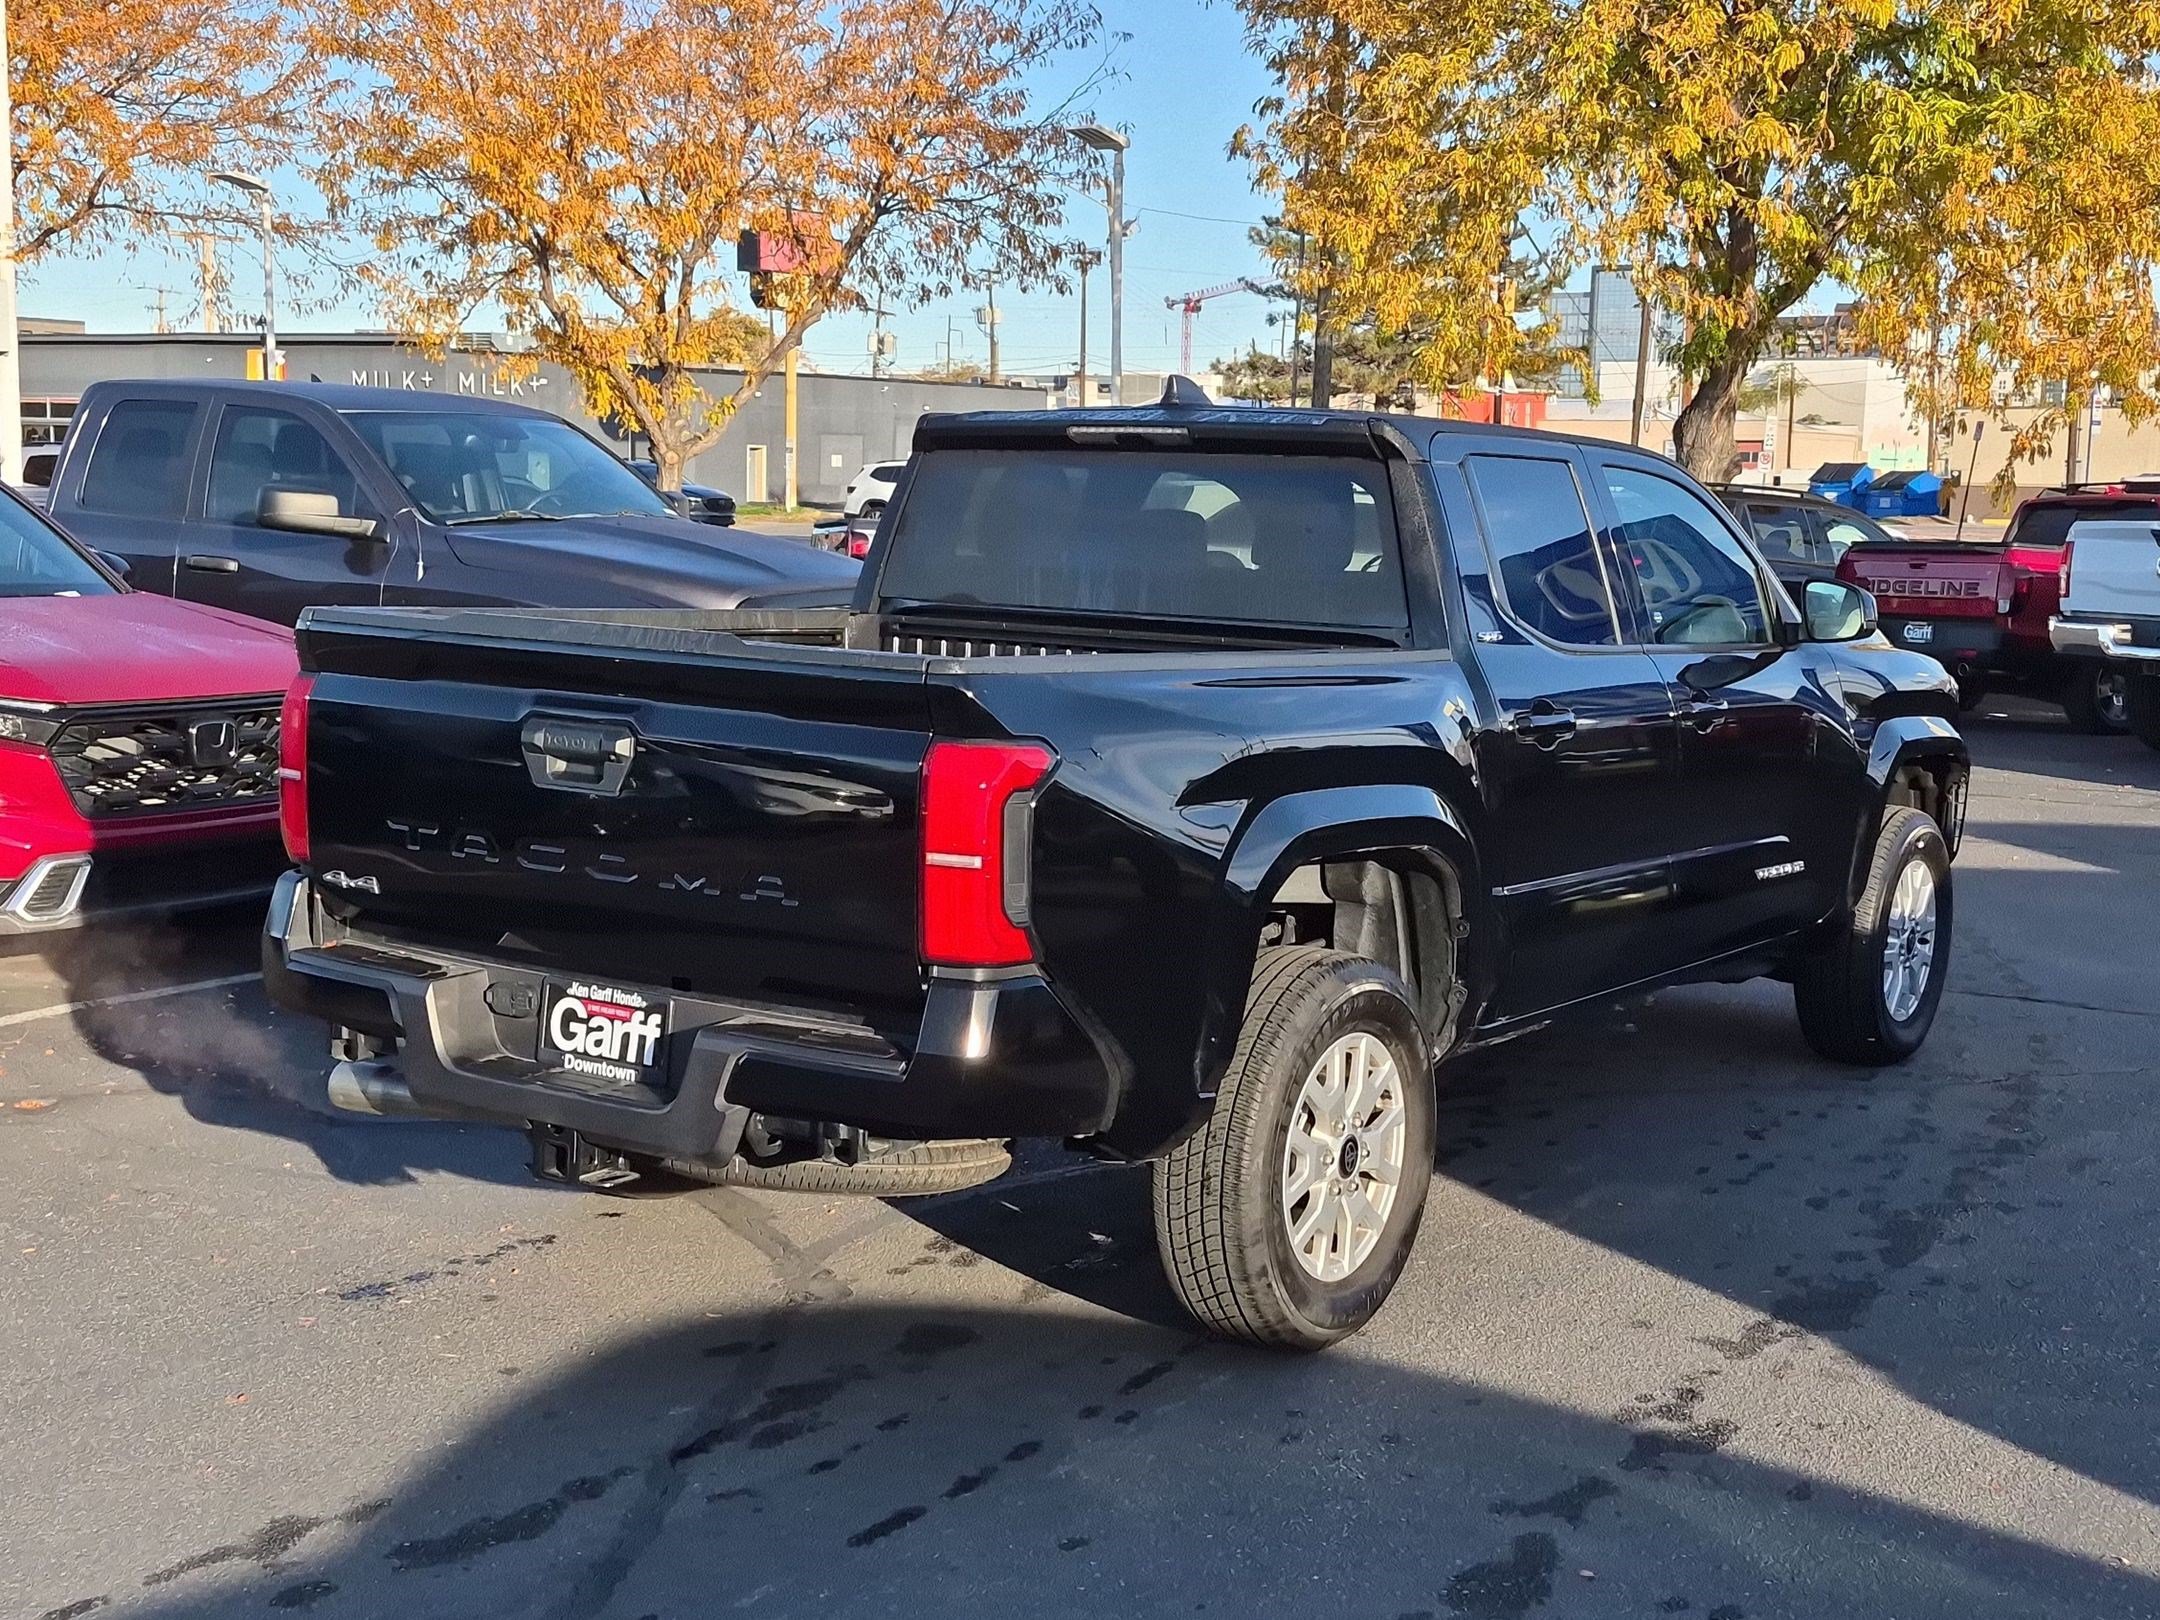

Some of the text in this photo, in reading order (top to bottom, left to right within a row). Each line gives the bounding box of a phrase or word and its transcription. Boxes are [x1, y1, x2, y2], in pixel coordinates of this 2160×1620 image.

[459, 372, 537, 396] MILK+
[1867, 579, 1981, 596] IDGELINE
[1904, 624, 1933, 639] Garff
[386, 819, 799, 906] TACOMA
[571, 981, 642, 1007] Ken Garff Honda
[550, 996, 661, 1067] Garff
[563, 1052, 637, 1082] Downtown
